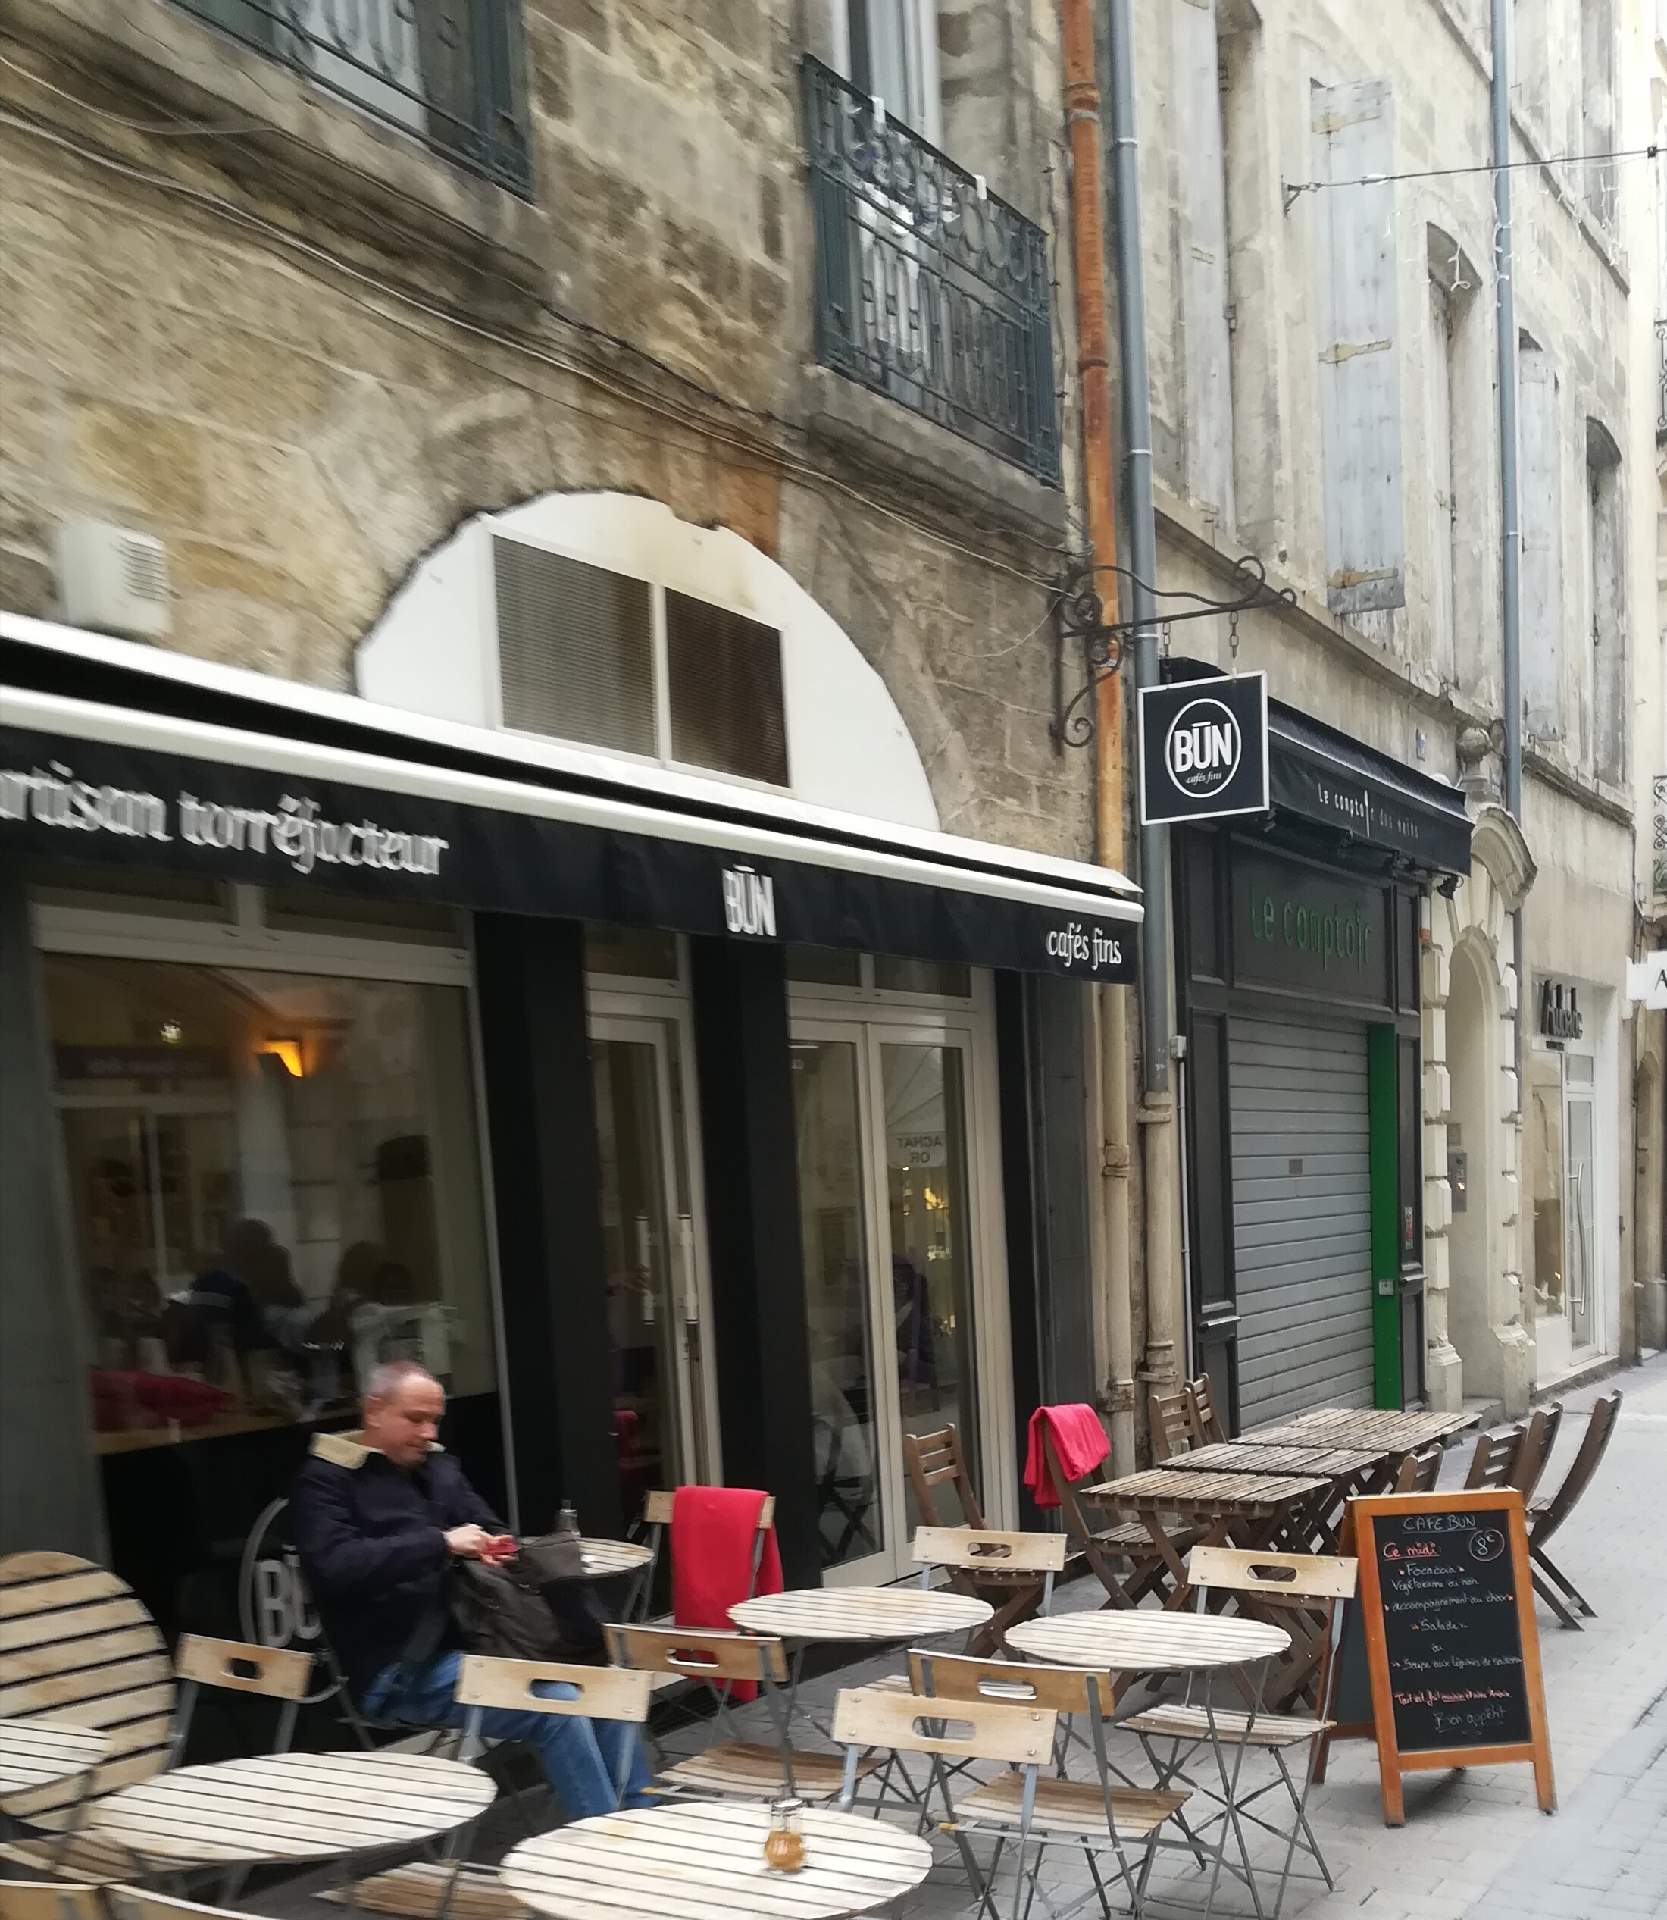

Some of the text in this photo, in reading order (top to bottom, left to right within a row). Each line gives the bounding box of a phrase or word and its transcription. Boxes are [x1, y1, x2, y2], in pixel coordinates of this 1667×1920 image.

[1185, 771, 1223, 786] cafés fins
[0, 759, 450, 876] rtisan torréfacteur
[1045, 921, 1123, 972] cafés fins
[1282, 900, 1374, 976] comptoir
[1383, 1542, 1401, 1558] Ce
